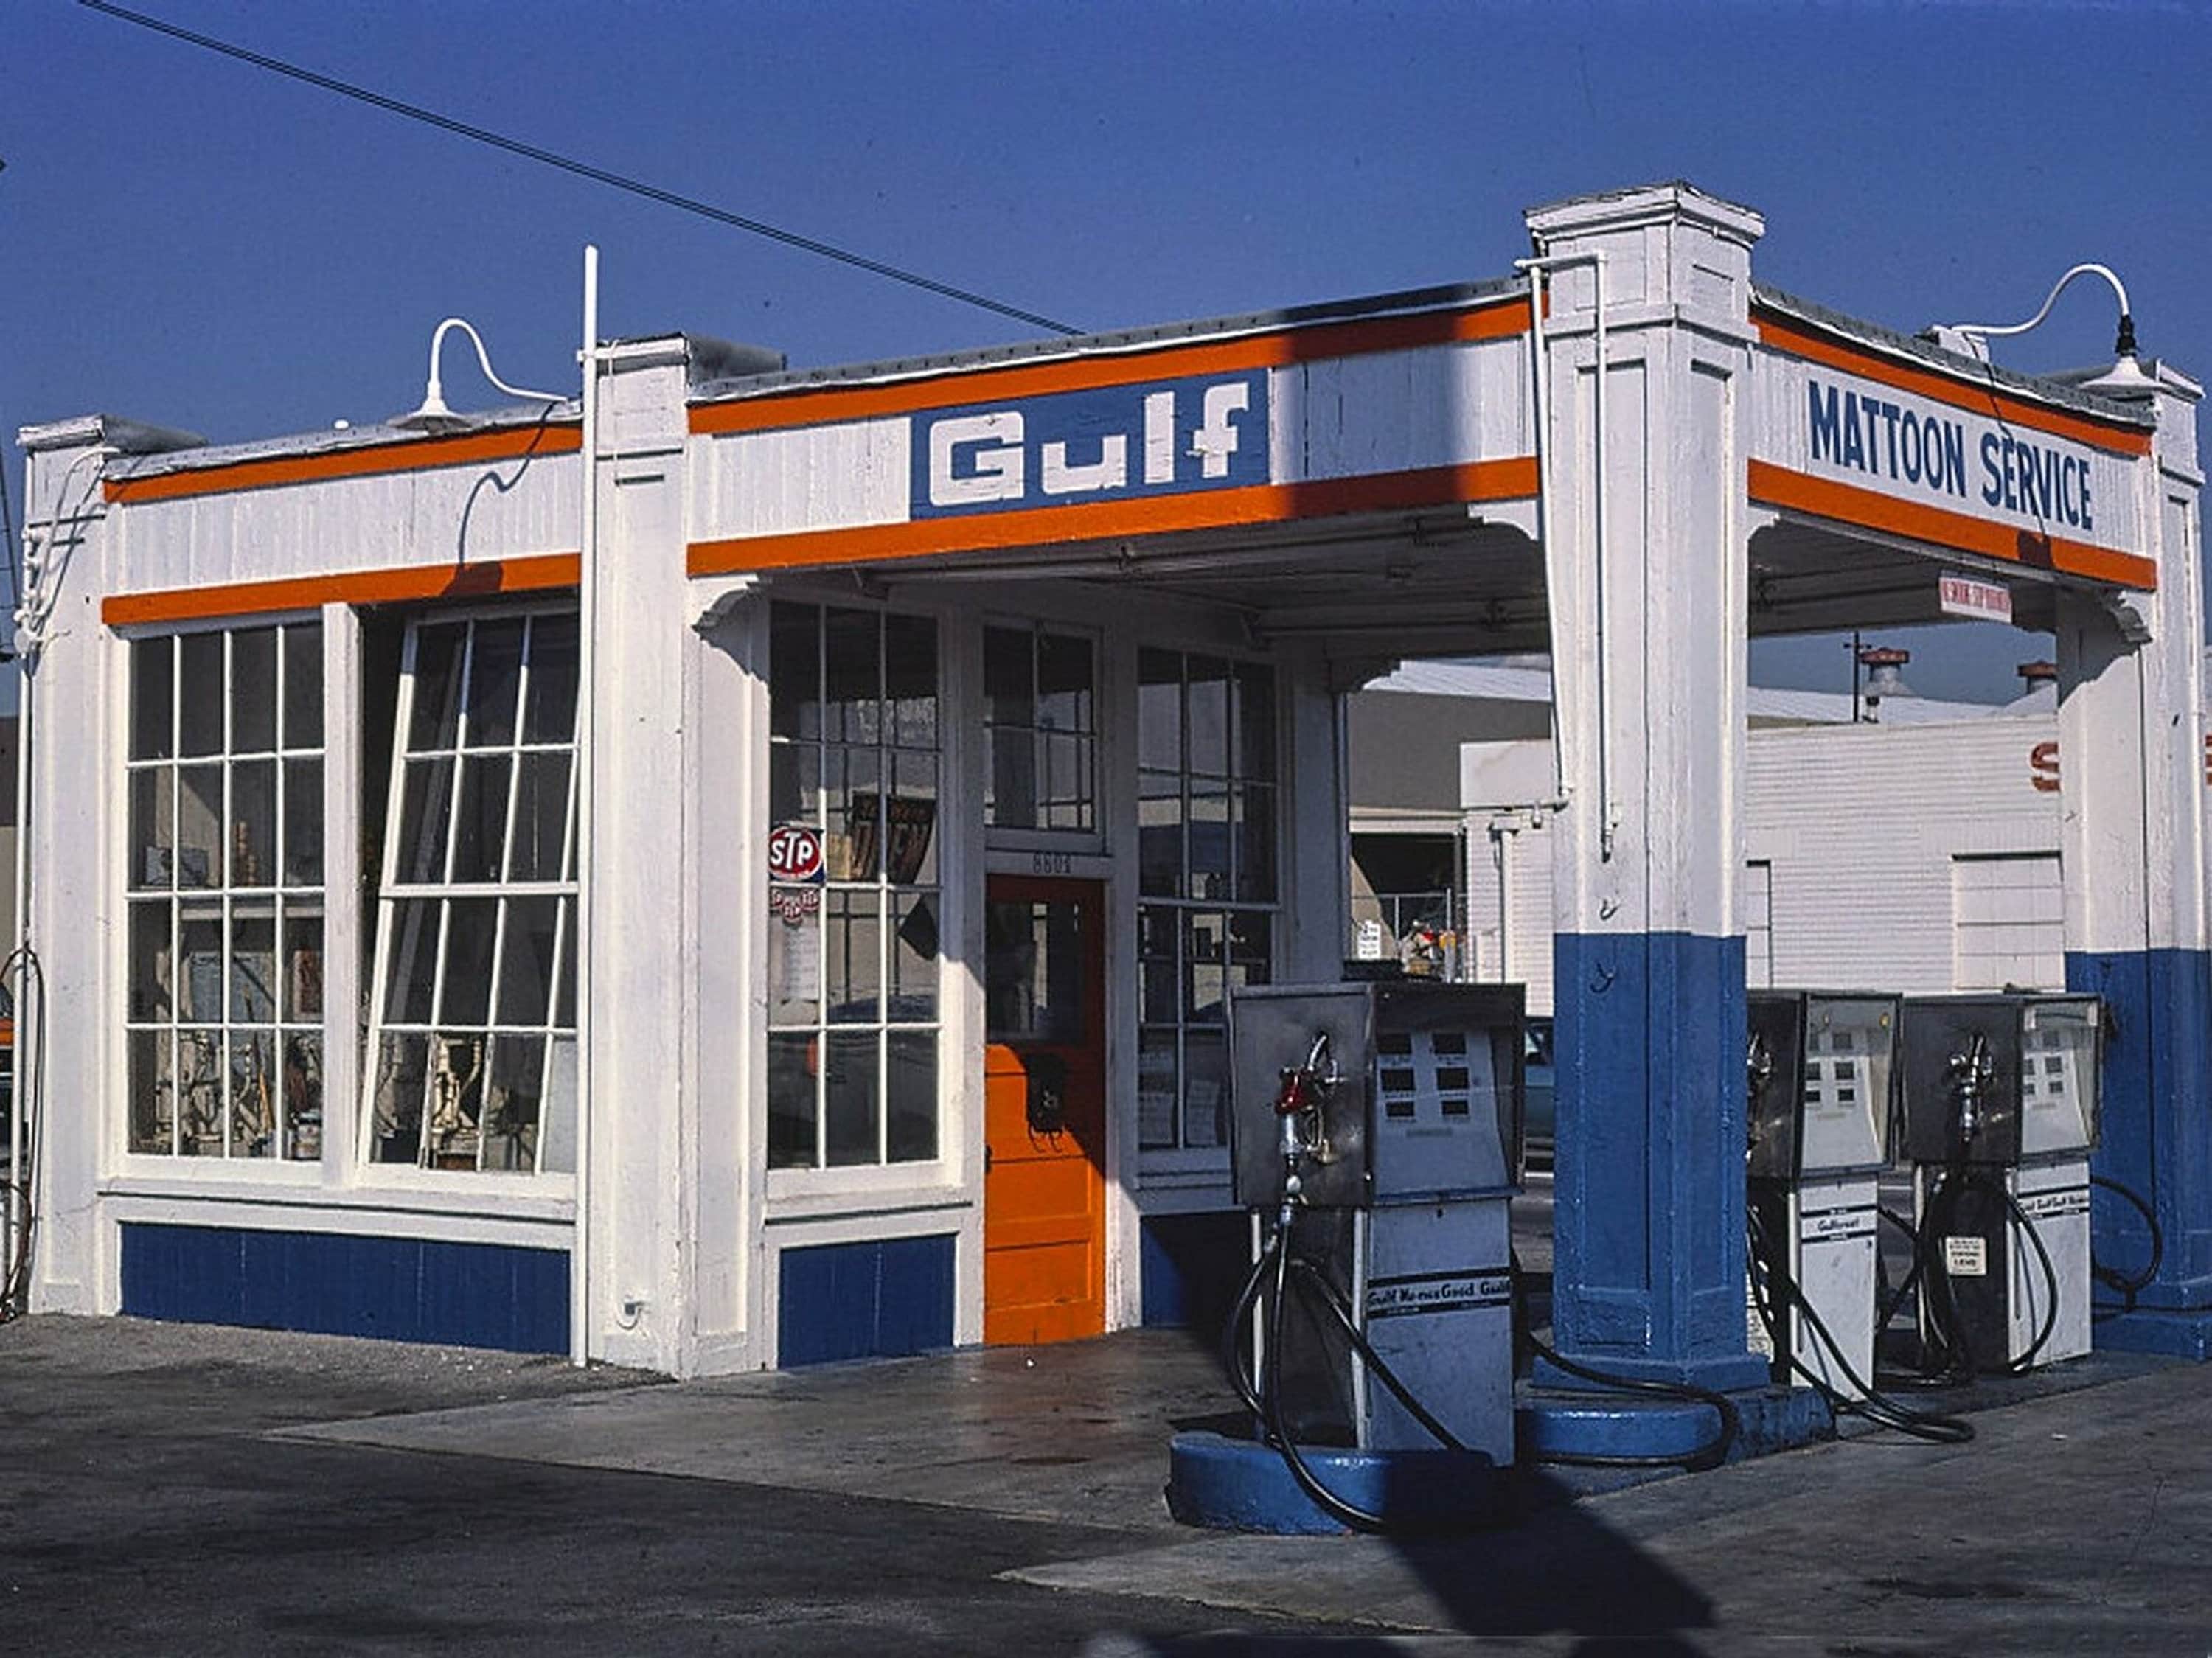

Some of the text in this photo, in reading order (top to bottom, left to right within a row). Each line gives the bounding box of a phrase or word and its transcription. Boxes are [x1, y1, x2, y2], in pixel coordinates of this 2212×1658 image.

[930, 382, 1249, 506] Gulf
[1809, 380, 2093, 531] MATTOON SERVICE
[771, 832, 813, 870] STP
